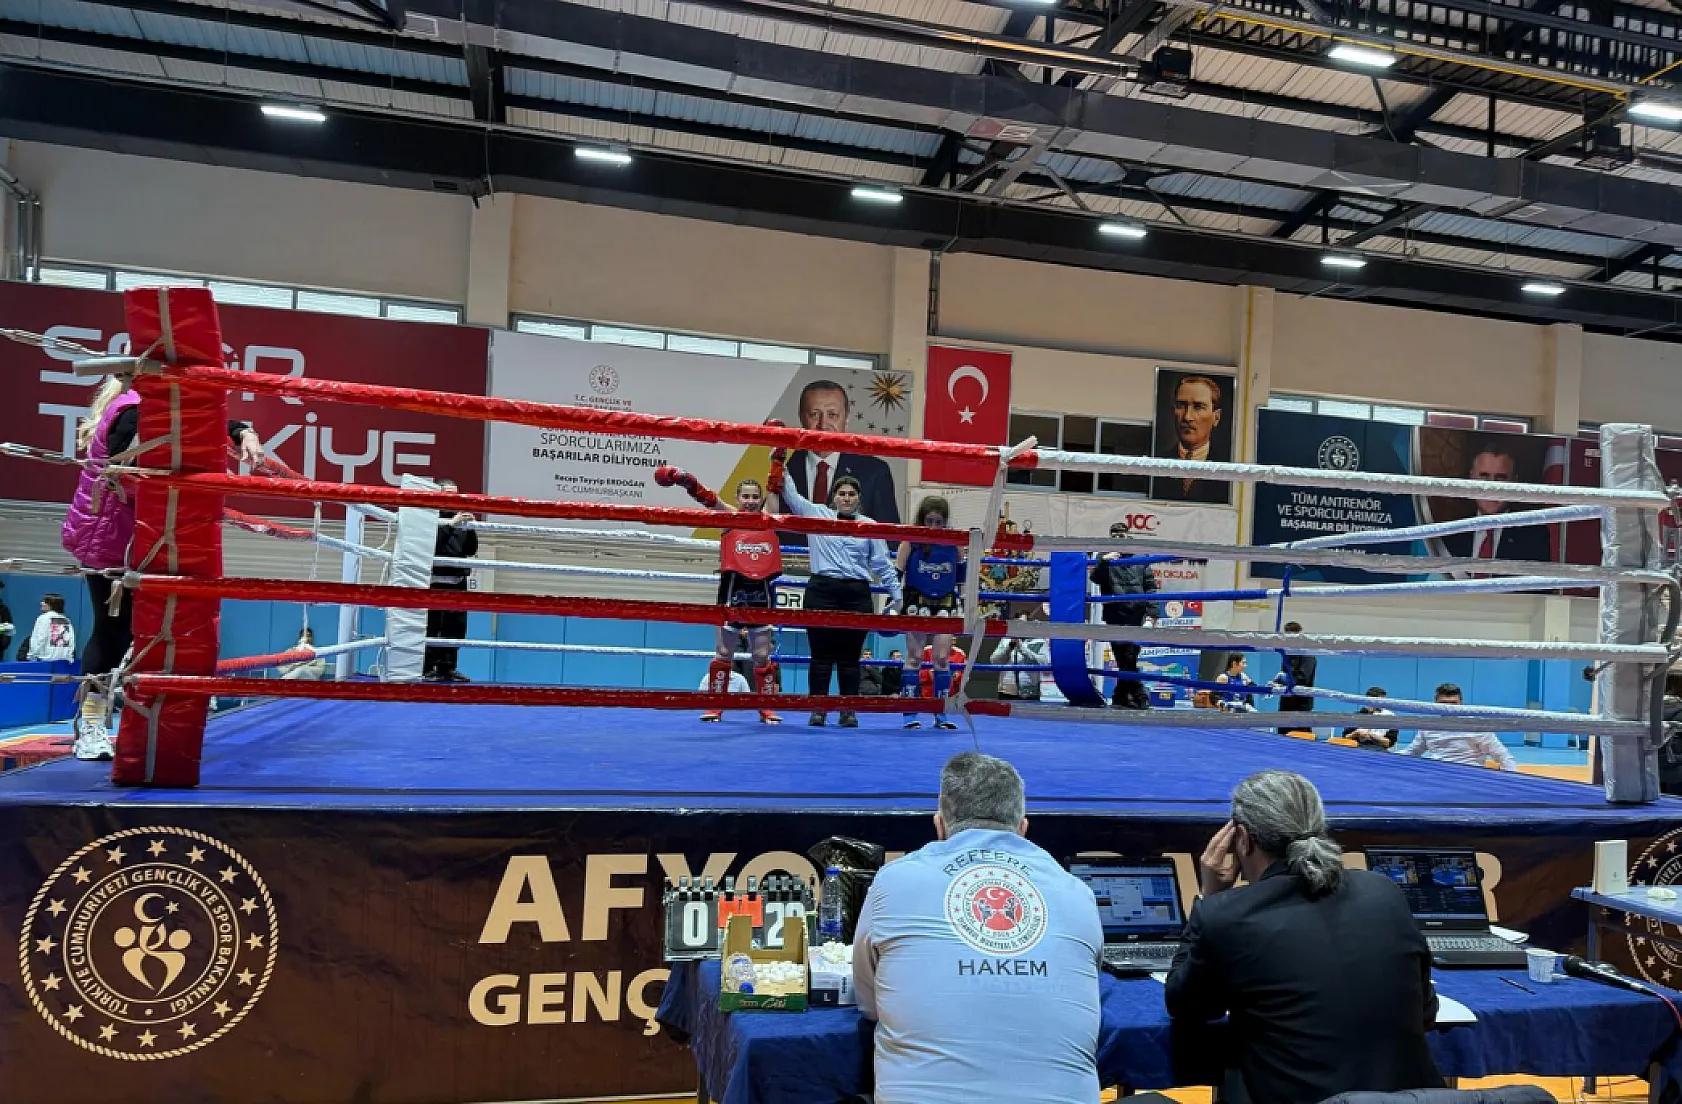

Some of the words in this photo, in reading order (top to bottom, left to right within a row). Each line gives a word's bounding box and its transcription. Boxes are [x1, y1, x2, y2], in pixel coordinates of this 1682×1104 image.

[39, 403, 436, 488] TKİYE
[540, 433, 660, 454] SPORCULARIMIZA
[532, 449, 600, 462] BAŞARILAR
[602, 453, 667, 467] DİLİYORUM
[555, 474, 578, 483] Recep
[580, 476, 605, 486] Tayyip
[606, 478, 645, 488] ERDOĞAN
[556, 484, 569, 492] T.C.
[573, 485, 643, 498] CUMHURBAŞKANI
[1290, 491, 1317, 504] TÜM
[1319, 496, 1381, 510] ANTRENÖR
[1278, 504, 1292, 516] VE
[1294, 505, 1393, 524] SPORCULARIMIZA
[1281, 518, 1334, 531] BAŞARILAR
[131, 868, 200, 892] GENÇLİK
[201, 885, 218, 905] VE
[70, 874, 130, 966] CUMHURİYETİ
[213, 904, 233, 944] SPOR
[683, 902, 709, 947] 0
[958, 959, 1048, 977] HAKEM
[76, 967, 129, 1015] TÜRKİYE
[170, 947, 233, 1014] BAKANLIĞI
[468, 969, 671, 1035] GENÇ
